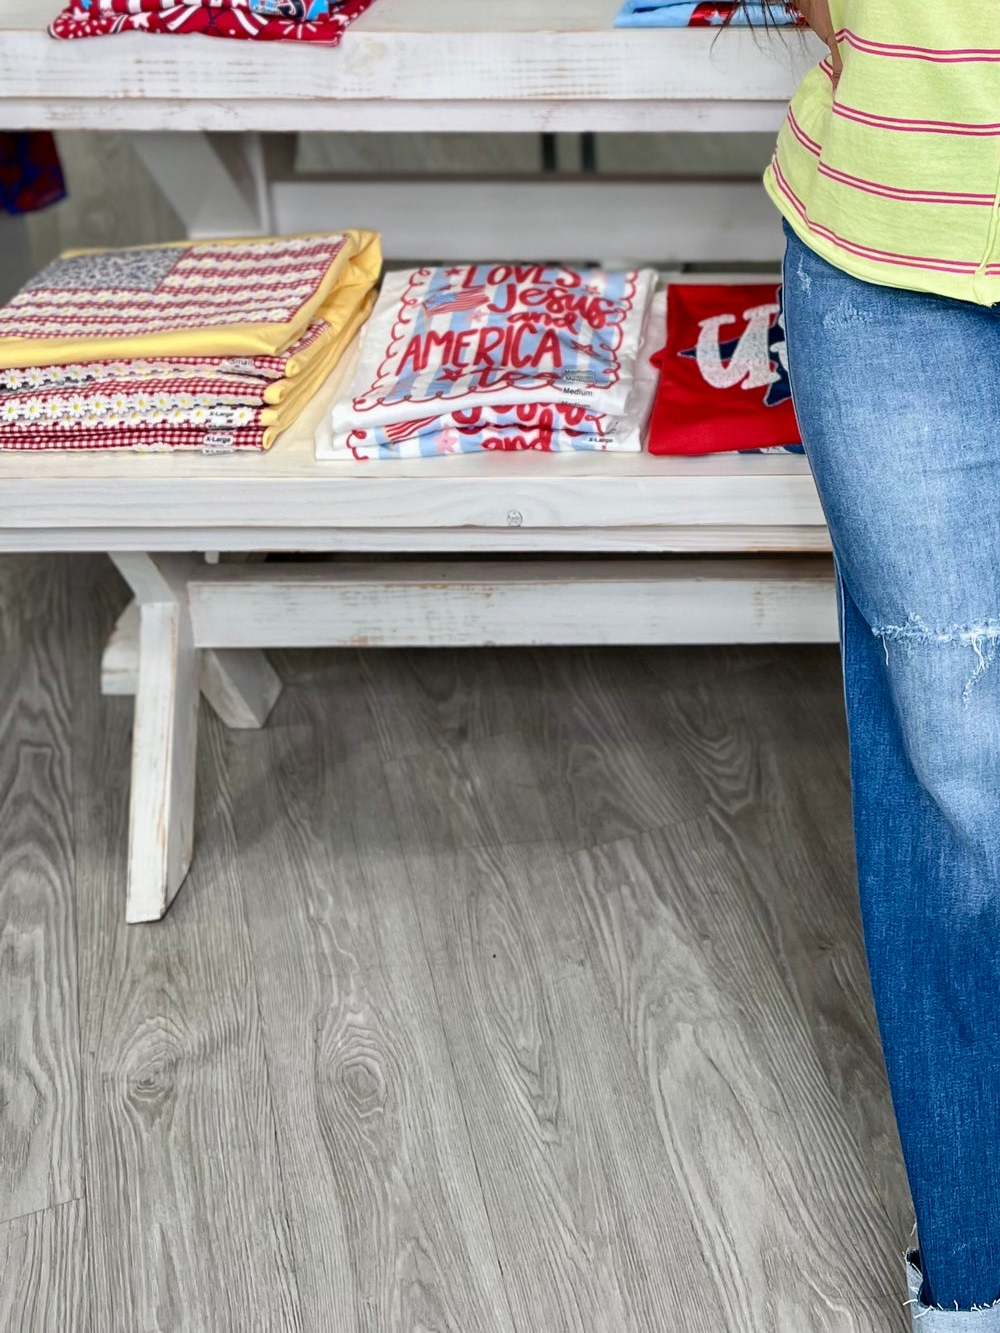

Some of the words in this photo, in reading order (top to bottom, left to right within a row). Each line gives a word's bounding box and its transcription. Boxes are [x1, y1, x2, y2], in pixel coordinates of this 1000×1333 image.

[487, 284, 614, 329] Jesus
[395, 323, 562, 376] AMERICA
[563, 387, 593, 397] Medium
[206, 435, 232, 445] X-Large
